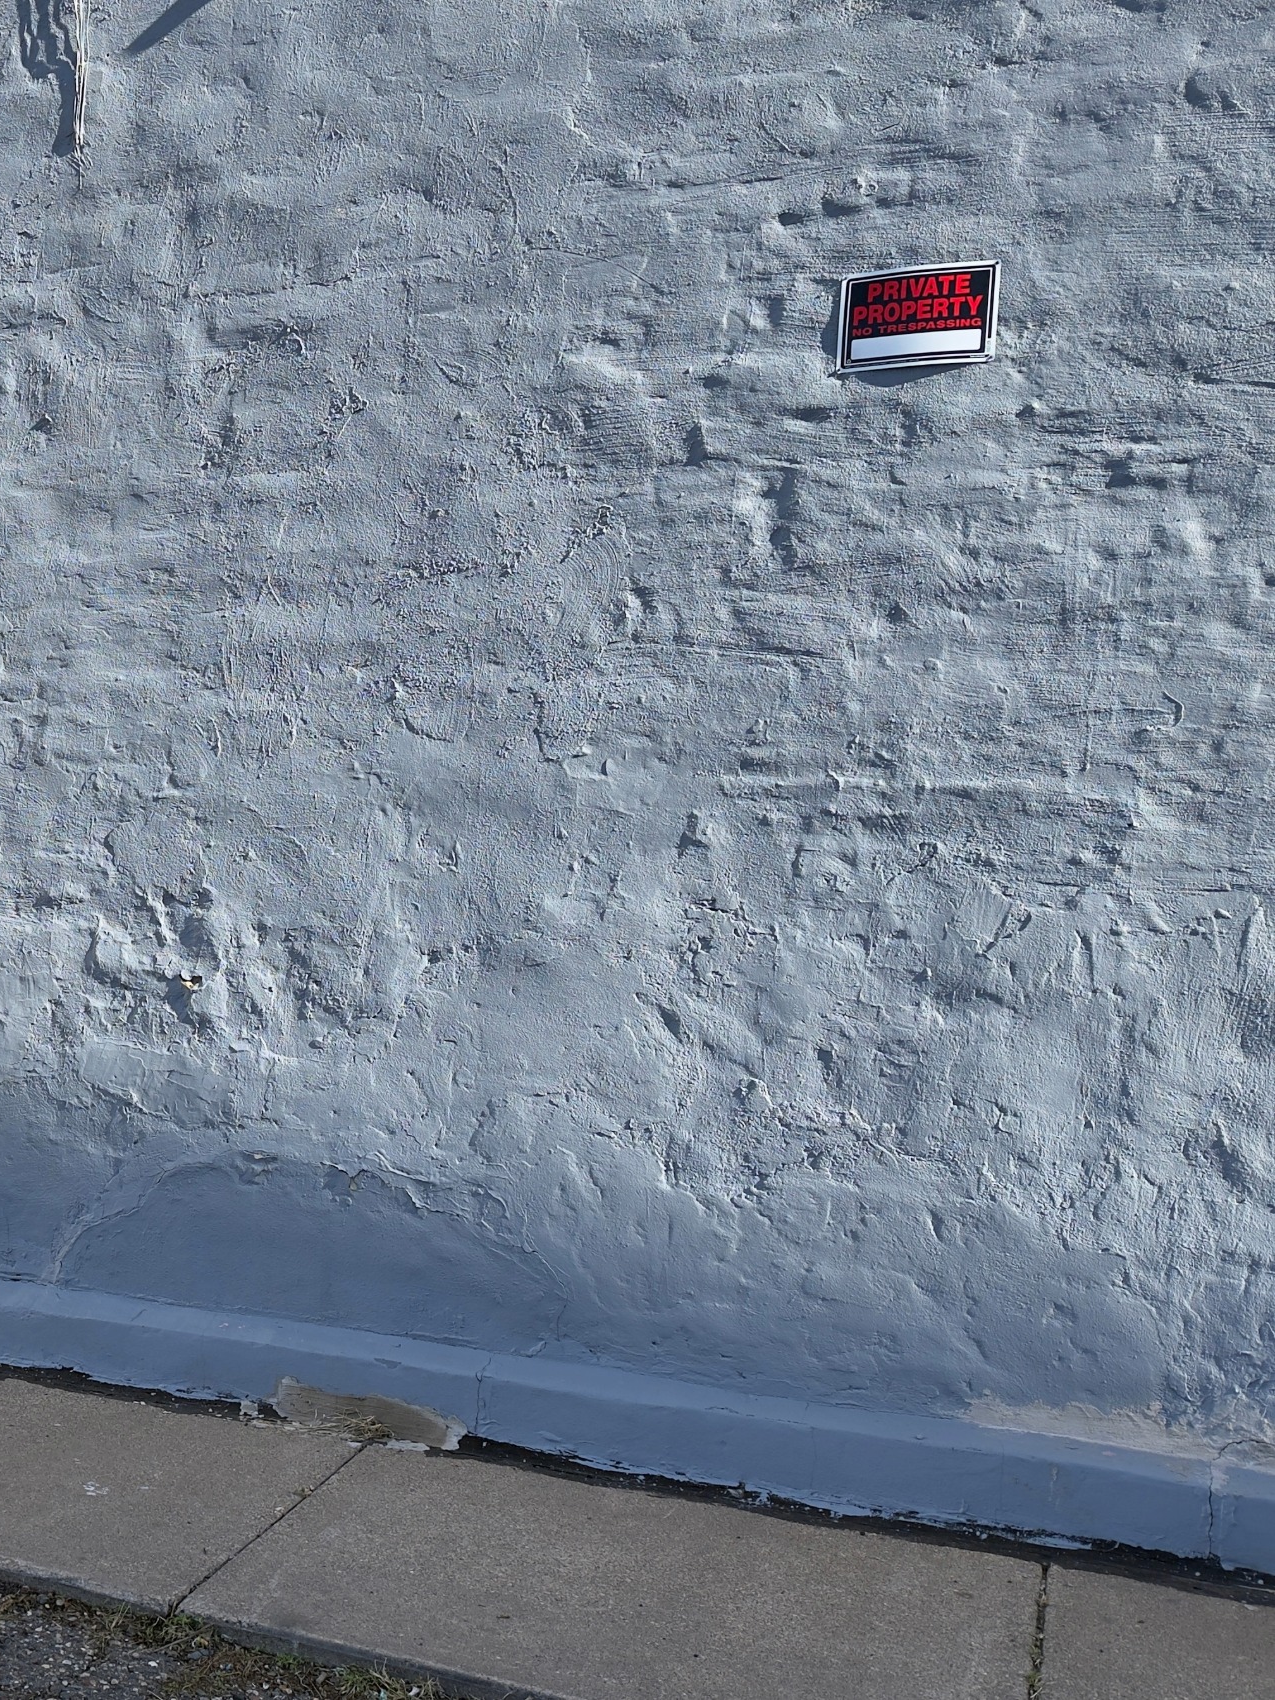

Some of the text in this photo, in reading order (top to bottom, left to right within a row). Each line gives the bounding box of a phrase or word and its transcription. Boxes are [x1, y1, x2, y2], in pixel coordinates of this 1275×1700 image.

[867, 273, 972, 303] PRIVATE
[853, 295, 983, 326] PROPERTY
[852, 317, 982, 337] NO TRESPASSING
